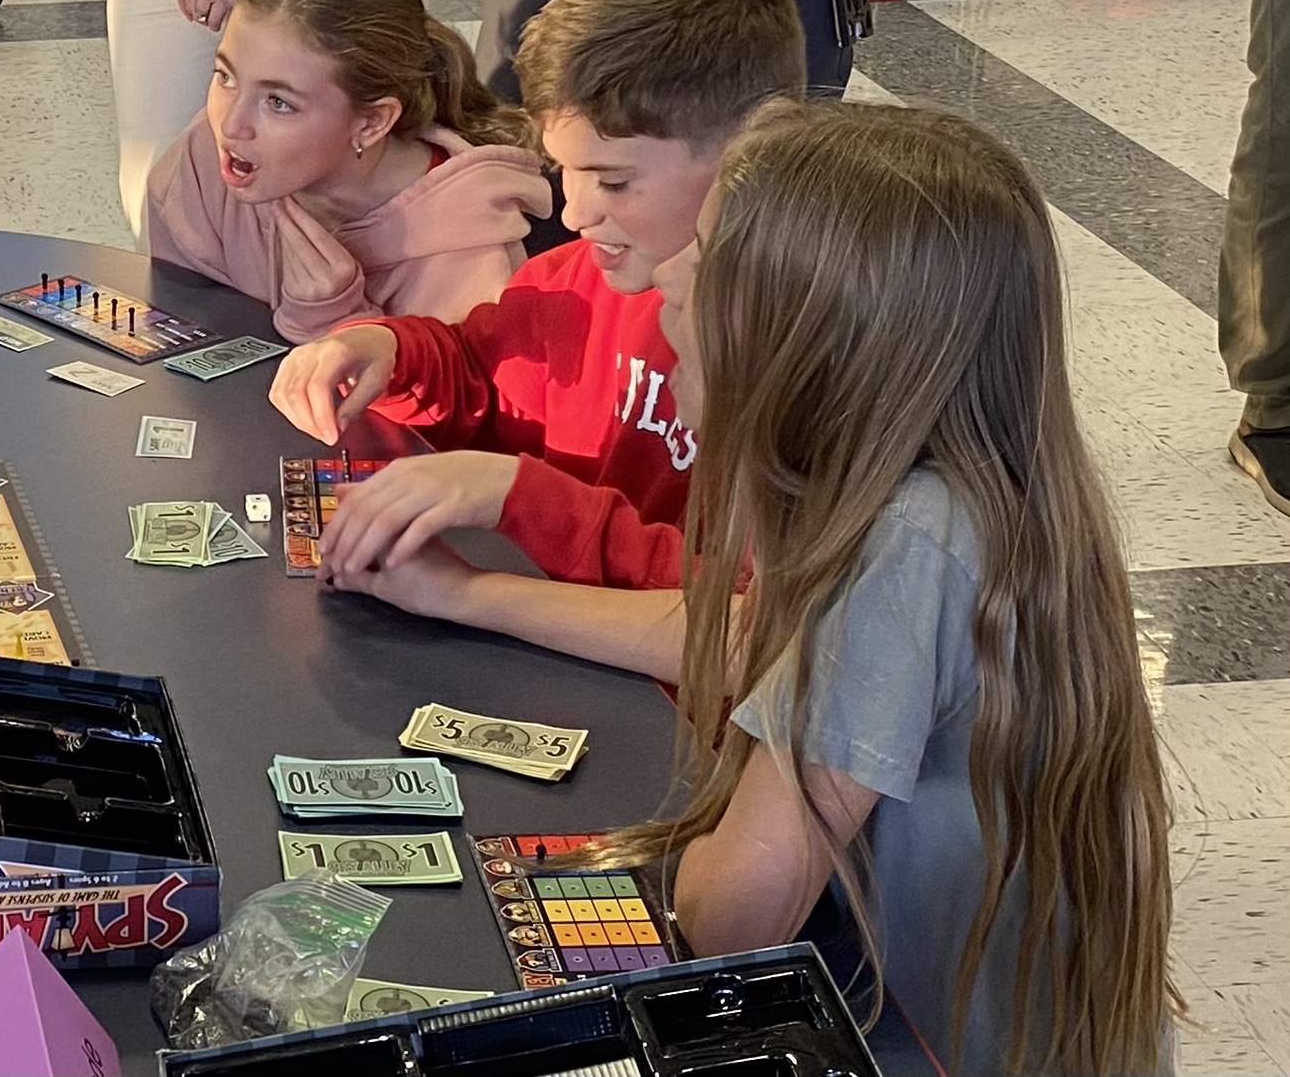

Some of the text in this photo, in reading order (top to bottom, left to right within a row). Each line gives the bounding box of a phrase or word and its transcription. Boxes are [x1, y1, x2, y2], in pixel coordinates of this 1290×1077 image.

[433, 714, 467, 740] $5
[536, 734, 570, 757] $5
[287, 771, 330, 795] $10
[395, 771, 438, 795] $10
[290, 842, 327, 868] $1
[402, 842, 439, 867] $1
[11, 880, 21, 888] to
[30, 877, 52, 887] Ages
[101, 875, 111, 883] to
[8, 893, 55, 906] SUSPENSE
[57, 893, 71, 904] OF
[72, 891, 100, 904] GAME
[101, 890, 121, 902] THE
[66, 872, 189, 956] SPY
